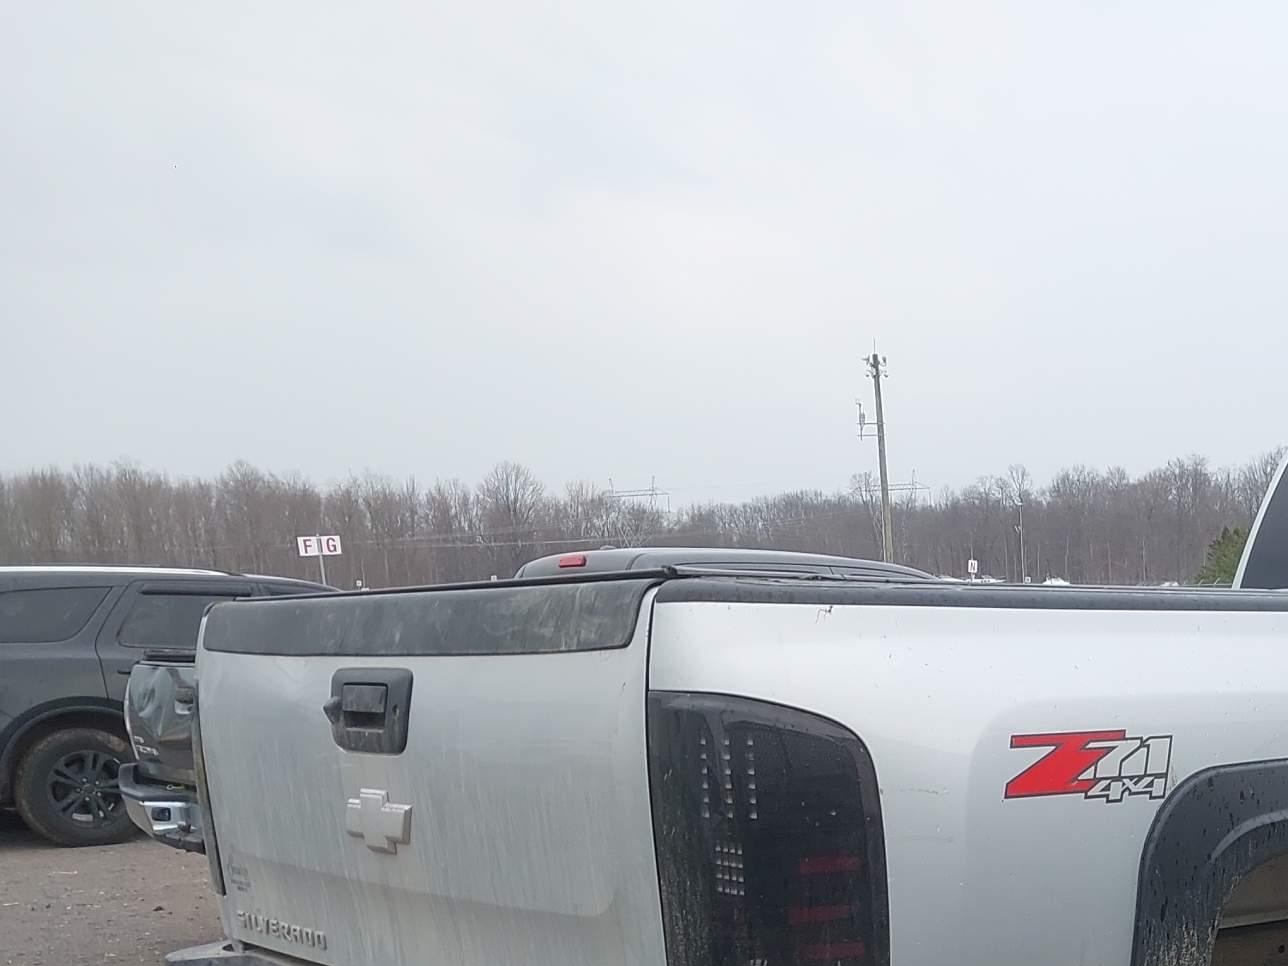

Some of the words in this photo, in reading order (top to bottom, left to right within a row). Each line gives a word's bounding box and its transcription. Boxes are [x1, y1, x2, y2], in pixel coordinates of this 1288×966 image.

[303, 538, 313, 554] F
[326, 537, 338, 553] G
[1004, 729, 1173, 800] Z71
